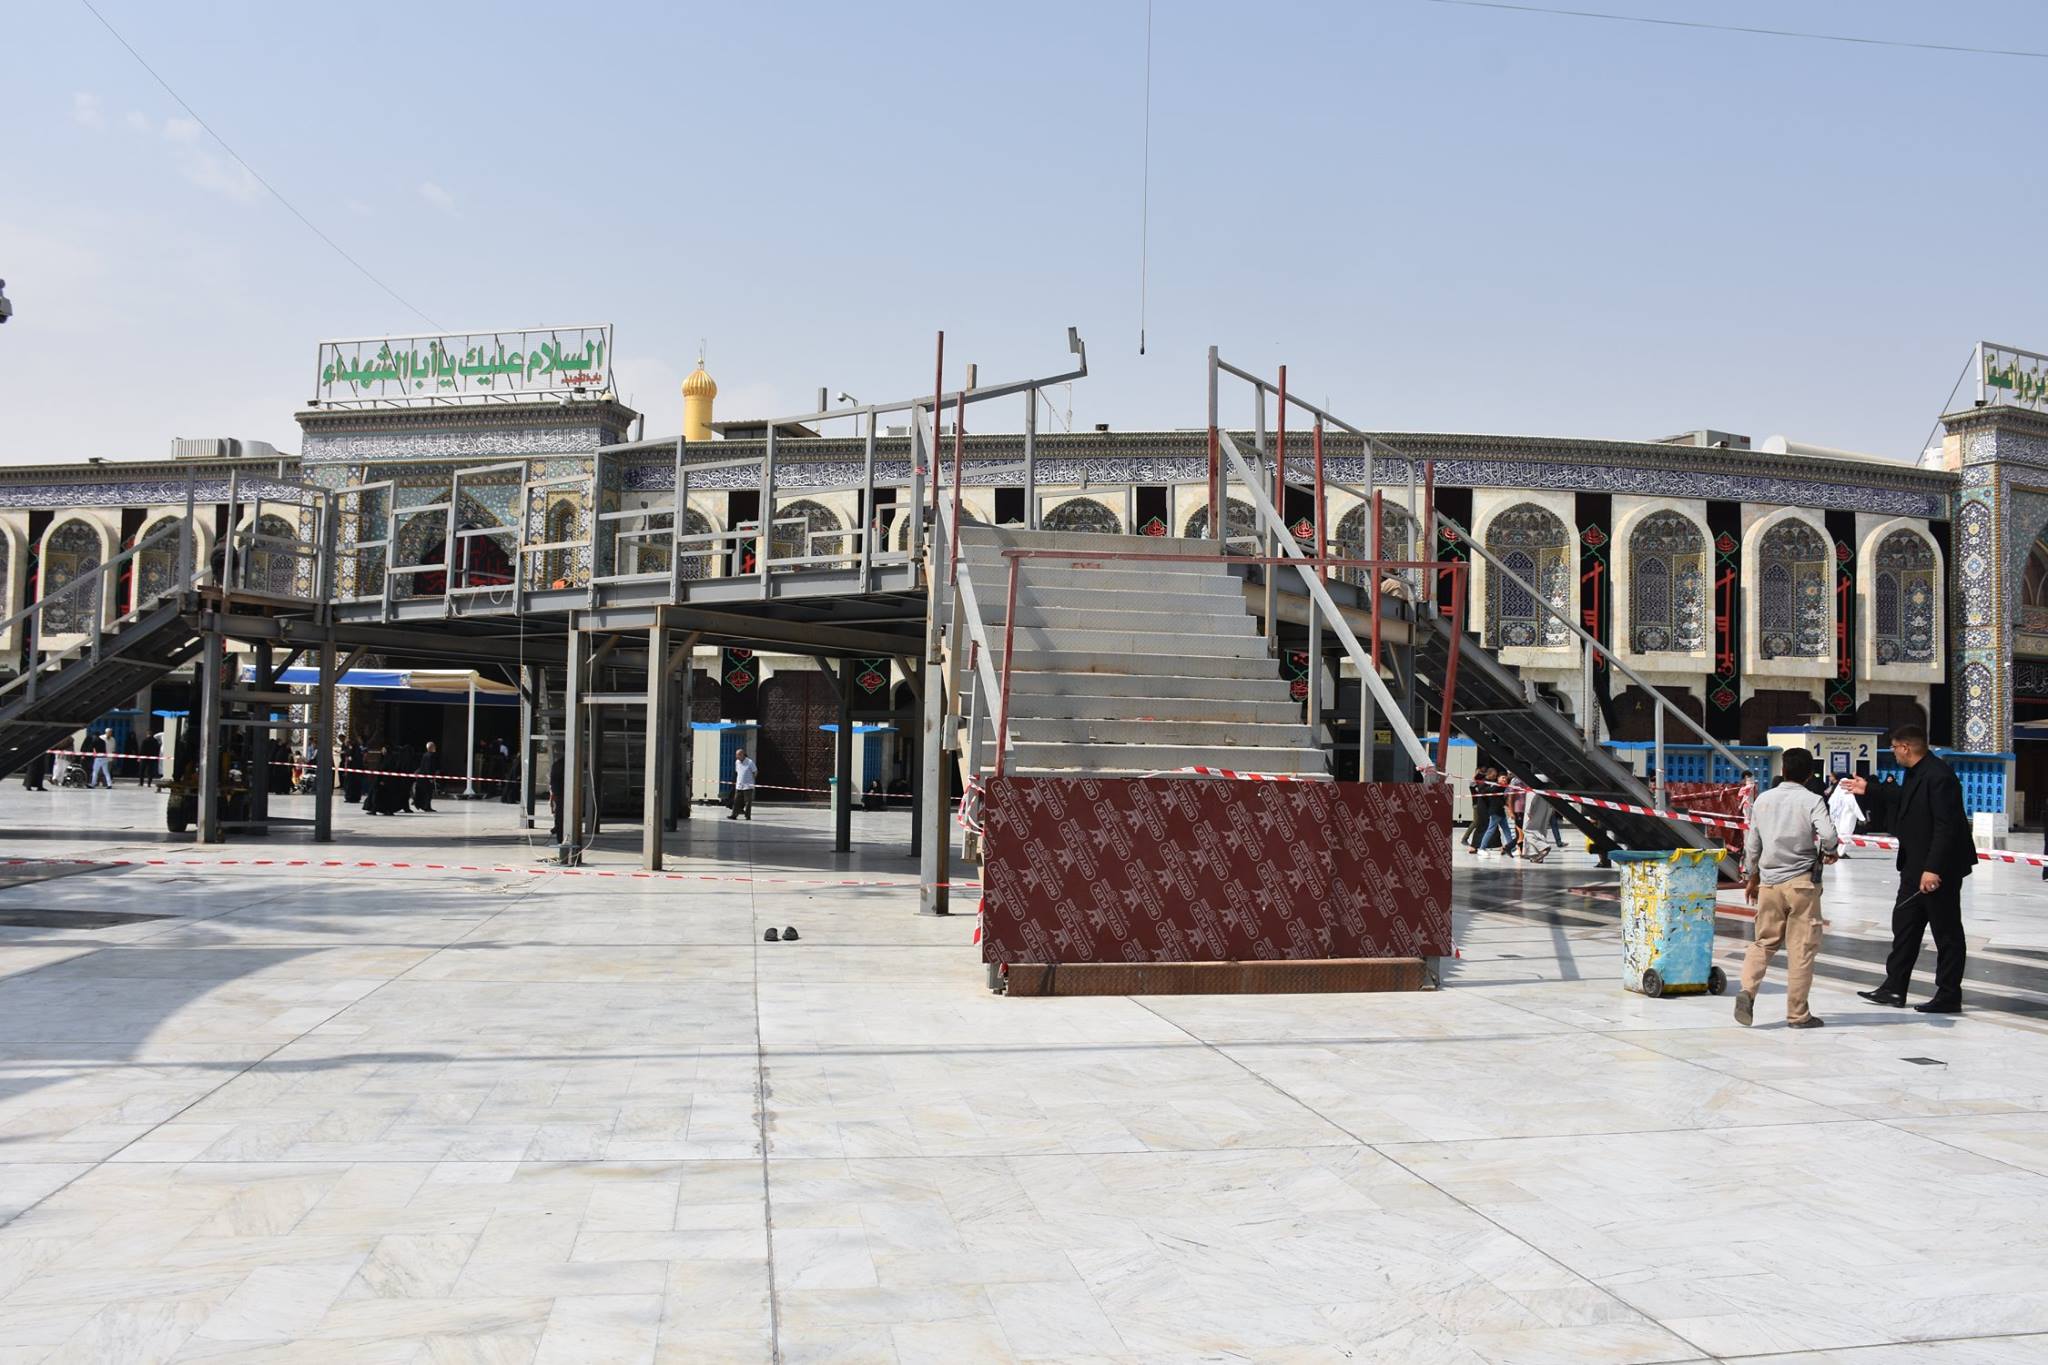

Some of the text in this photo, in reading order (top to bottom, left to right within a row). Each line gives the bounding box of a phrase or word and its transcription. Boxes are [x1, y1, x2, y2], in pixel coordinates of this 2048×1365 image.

[322, 345, 409, 389] الشهداء
[458, 344, 524, 386] عليك
[526, 339, 603, 383] السلام
[1813, 743, 1821, 756] 1
[1859, 744, 1868, 757] 2
[994, 784, 1010, 807] PLEX
[1081, 777, 1095, 796] ROY
[1130, 786, 1146, 809] PLEX
[1214, 781, 1228, 798] ROY
[1261, 789, 1277, 811] PLEX
[1041, 787, 1060, 816] ROYAL
[1176, 789, 1195, 817] ROYAL
[1305, 791, 1324, 818] ROYAL
[1369, 786, 1387, 813] ROYAL
[1383, 812, 1398, 834] PLEX
[1414, 794, 1429, 816] PLEX
[1006, 807, 1025, 835] ROYAL
[1096, 806, 1127, 856] ROYAL PLEX
[1142, 809, 1161, 837] ROYAL
[1228, 808, 1258, 857] ROYAL PLEX
[1272, 810, 1291, 838] ROYAL
[1337, 804, 1366, 853] ROYAL PLEX
[1061, 825, 1092, 876] ROYAL PLEX
[1196, 827, 1225, 876] ROYAL PLEX
[1429, 825, 1447, 852] ROYAL
[1026, 845, 1042, 868] PLEX
[1397, 843, 1415, 870] ROYAL
[1411, 869, 1426, 890] PLEX
[1038, 867, 1057, 896] ROYAL
[1162, 846, 1192, 896] ROYAL PLEX
[1291, 847, 1321, 895] ROYAL PLEX
[990, 865, 1022, 916] ROYAL PLEX
[1093, 885, 1109, 908] PLEX
[1127, 866, 1158, 916] ROYAL PLEX
[1226, 885, 1241, 908] PLEX
[1259, 866, 1289, 915] ROYAL PLEX
[1366, 862, 1384, 889] ROYAL
[1380, 889, 1395, 910] PLEX
[1057, 905, 1074, 929] PLEX
[1192, 905, 1208, 928] PLEX
[1334, 881, 1363, 929] ROYAL PLEX
[1427, 900, 1443, 925] ROYAL
[1105, 908, 1124, 936] ROYAL
[1237, 907, 1256, 935] ROYAL
[1395, 919, 1413, 945] ROYAL
[1069, 928, 1089, 956] ROYAL
[1158, 925, 1174, 948] PLEX
[1204, 927, 1223, 955] ROYAL
